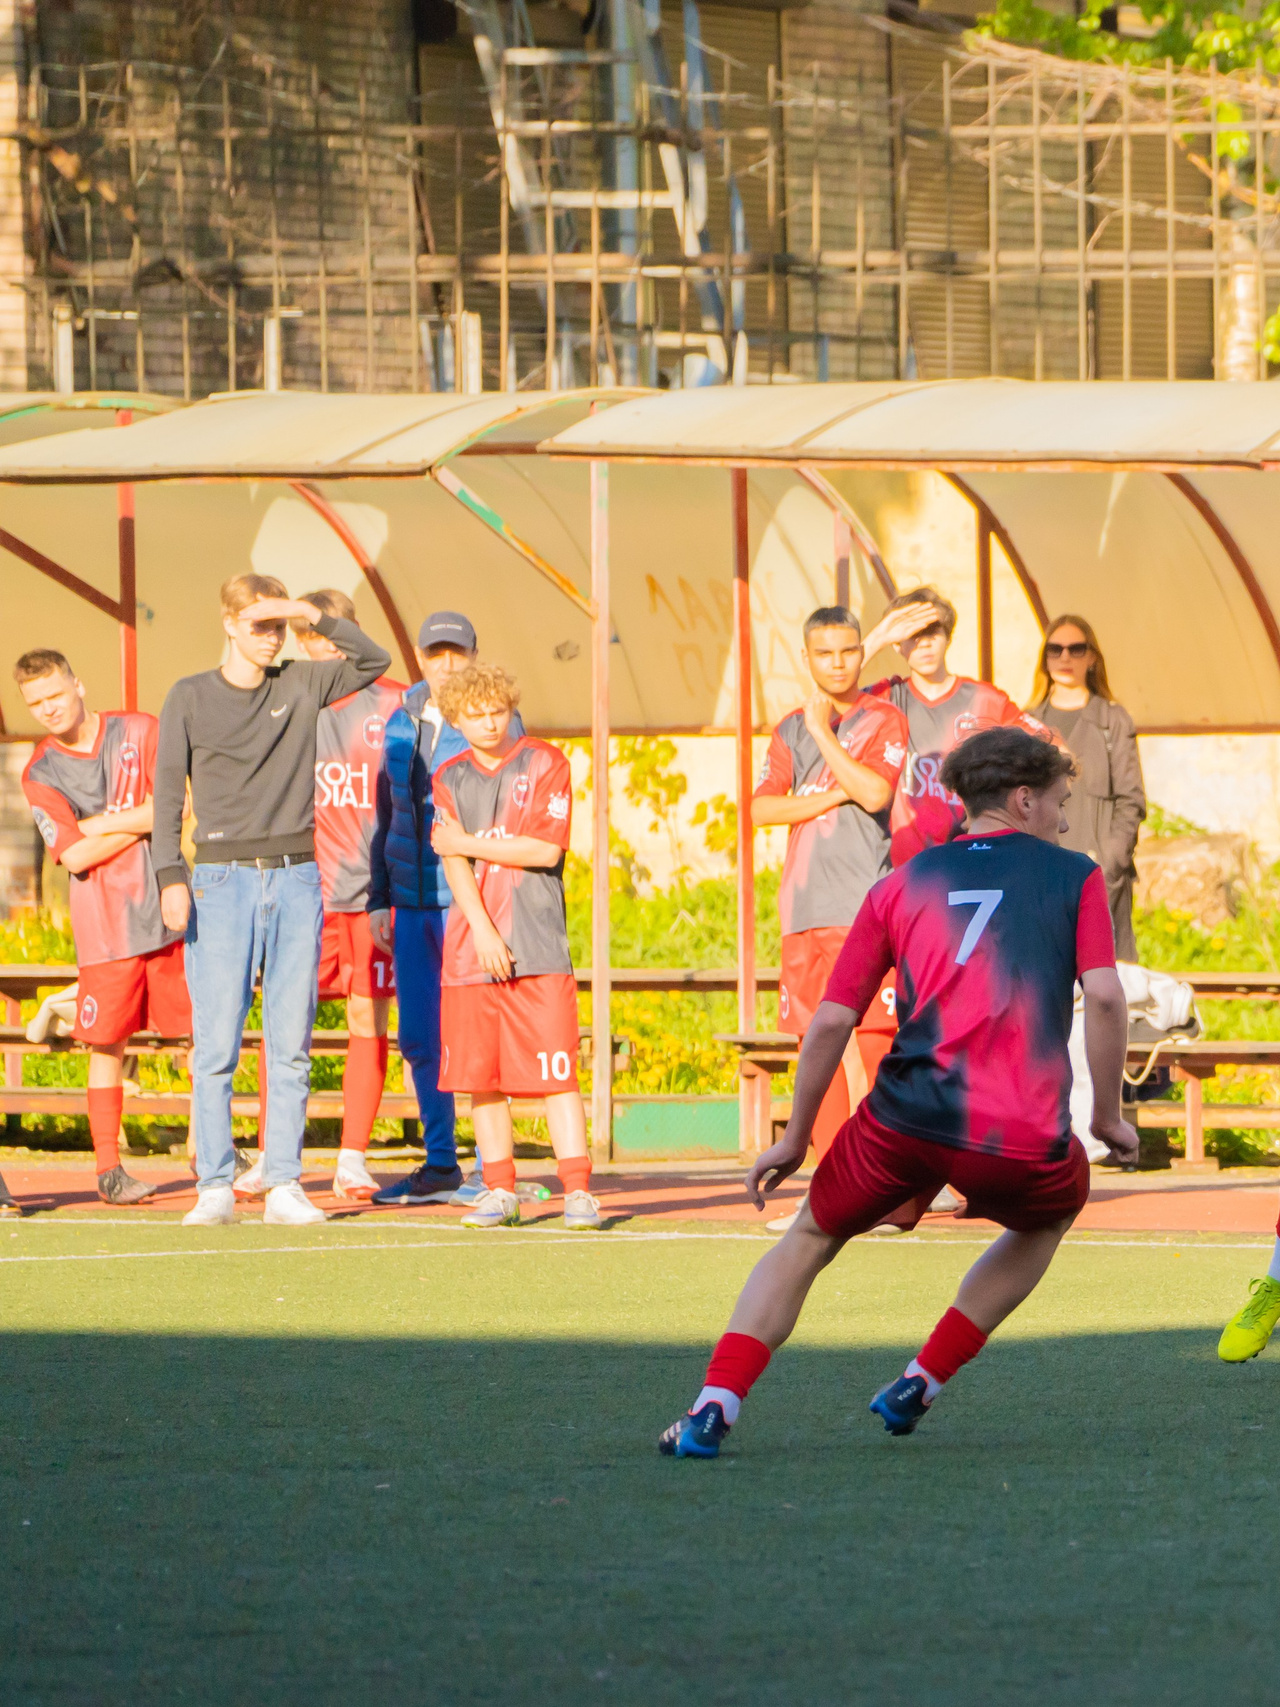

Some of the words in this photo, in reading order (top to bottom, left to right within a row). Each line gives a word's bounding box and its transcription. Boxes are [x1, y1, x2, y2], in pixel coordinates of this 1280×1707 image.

[948, 889, 1004, 966] 7
[880, 986, 897, 1016] 9
[536, 1050, 571, 1081] 10
[897, 1385, 917, 1401] COPA
